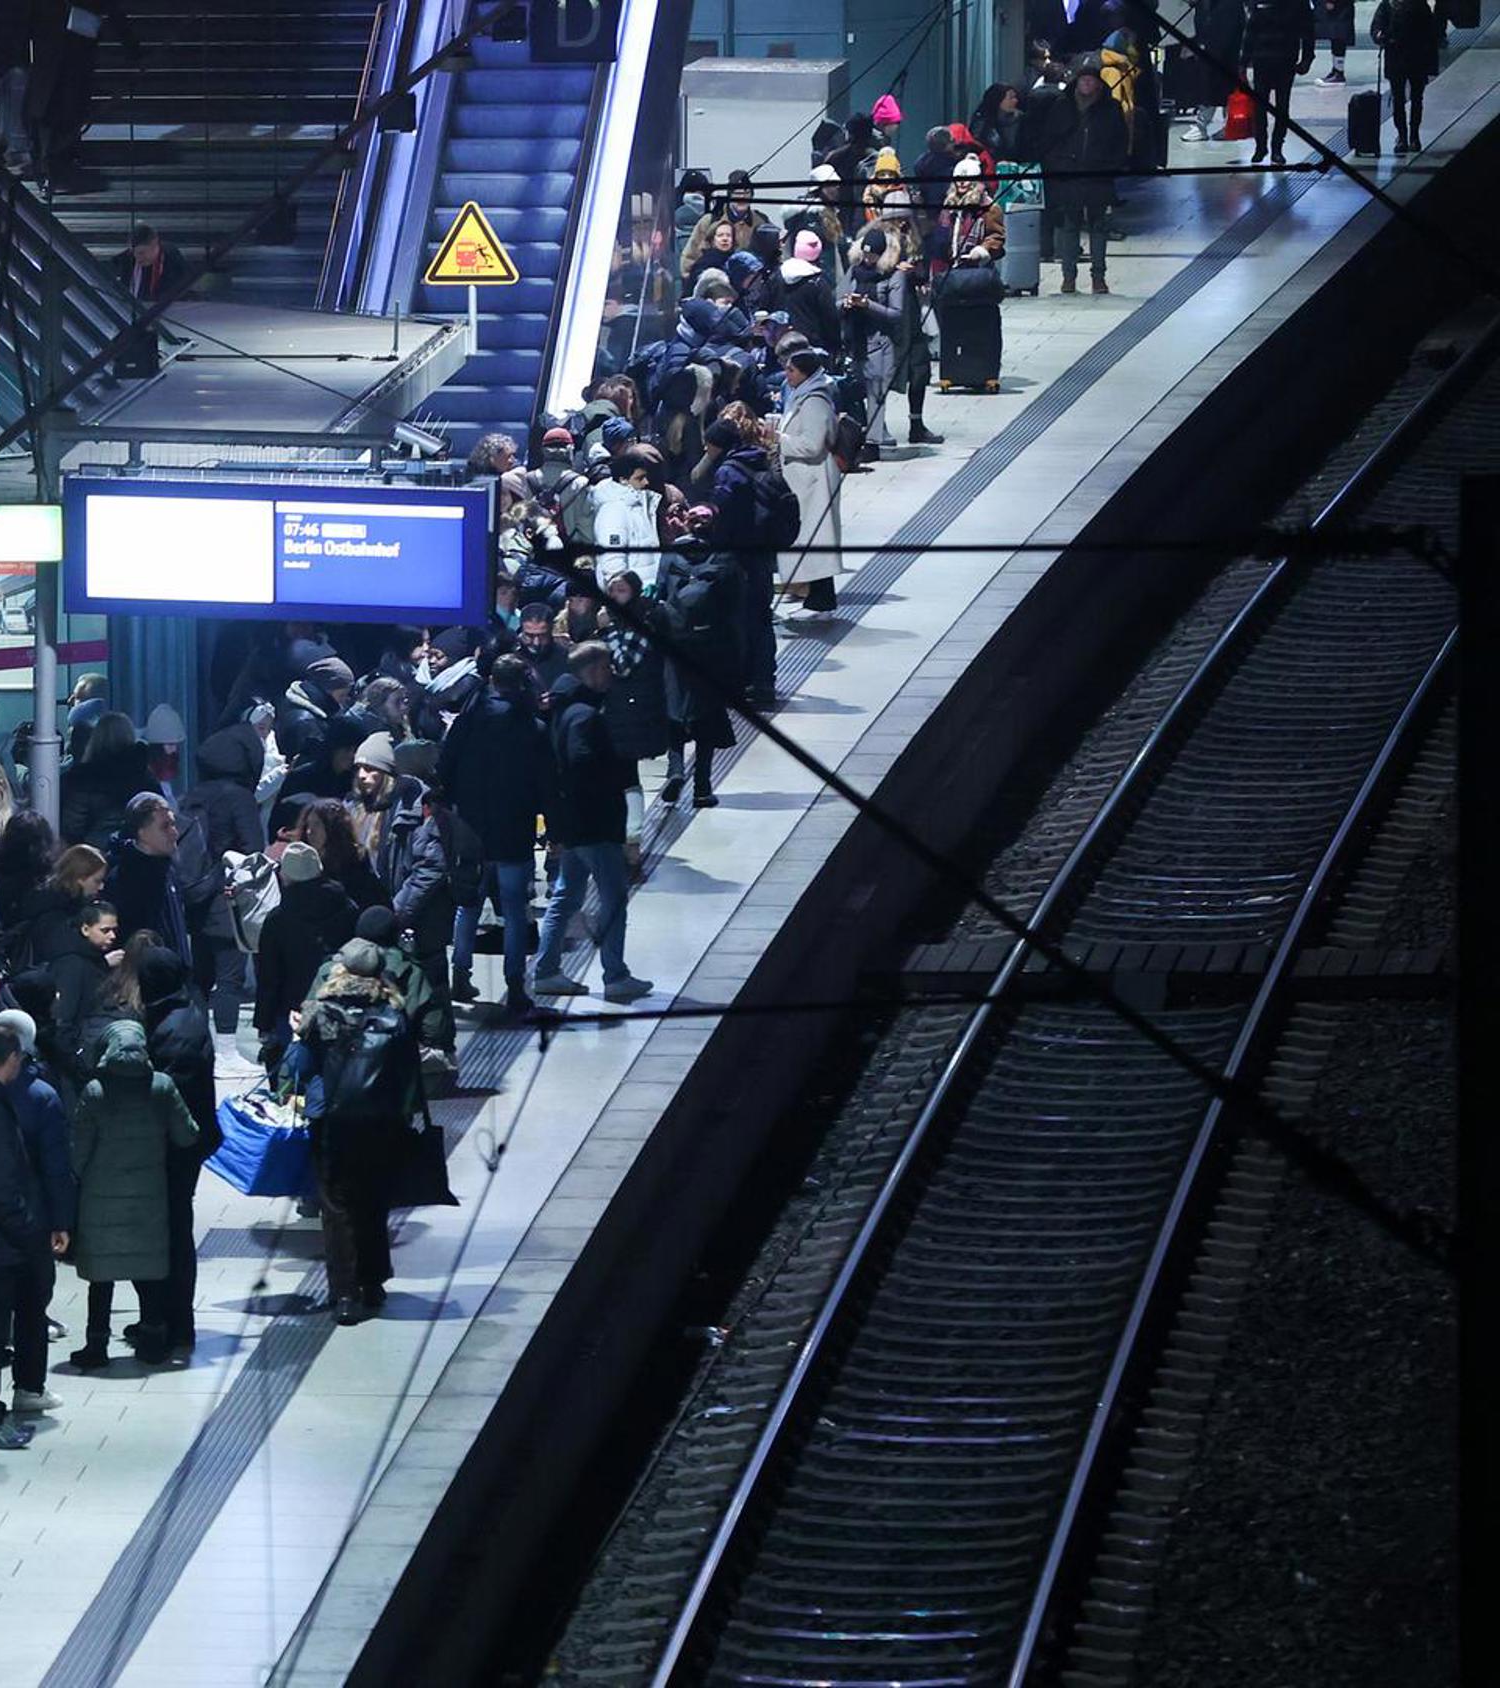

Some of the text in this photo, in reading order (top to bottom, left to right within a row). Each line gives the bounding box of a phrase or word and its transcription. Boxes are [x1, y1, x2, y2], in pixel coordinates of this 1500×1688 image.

[557, 0, 601, 48] D
[283, 522, 320, 537] 07:46
[284, 538, 401, 558] Berlin Ostbahnhof
